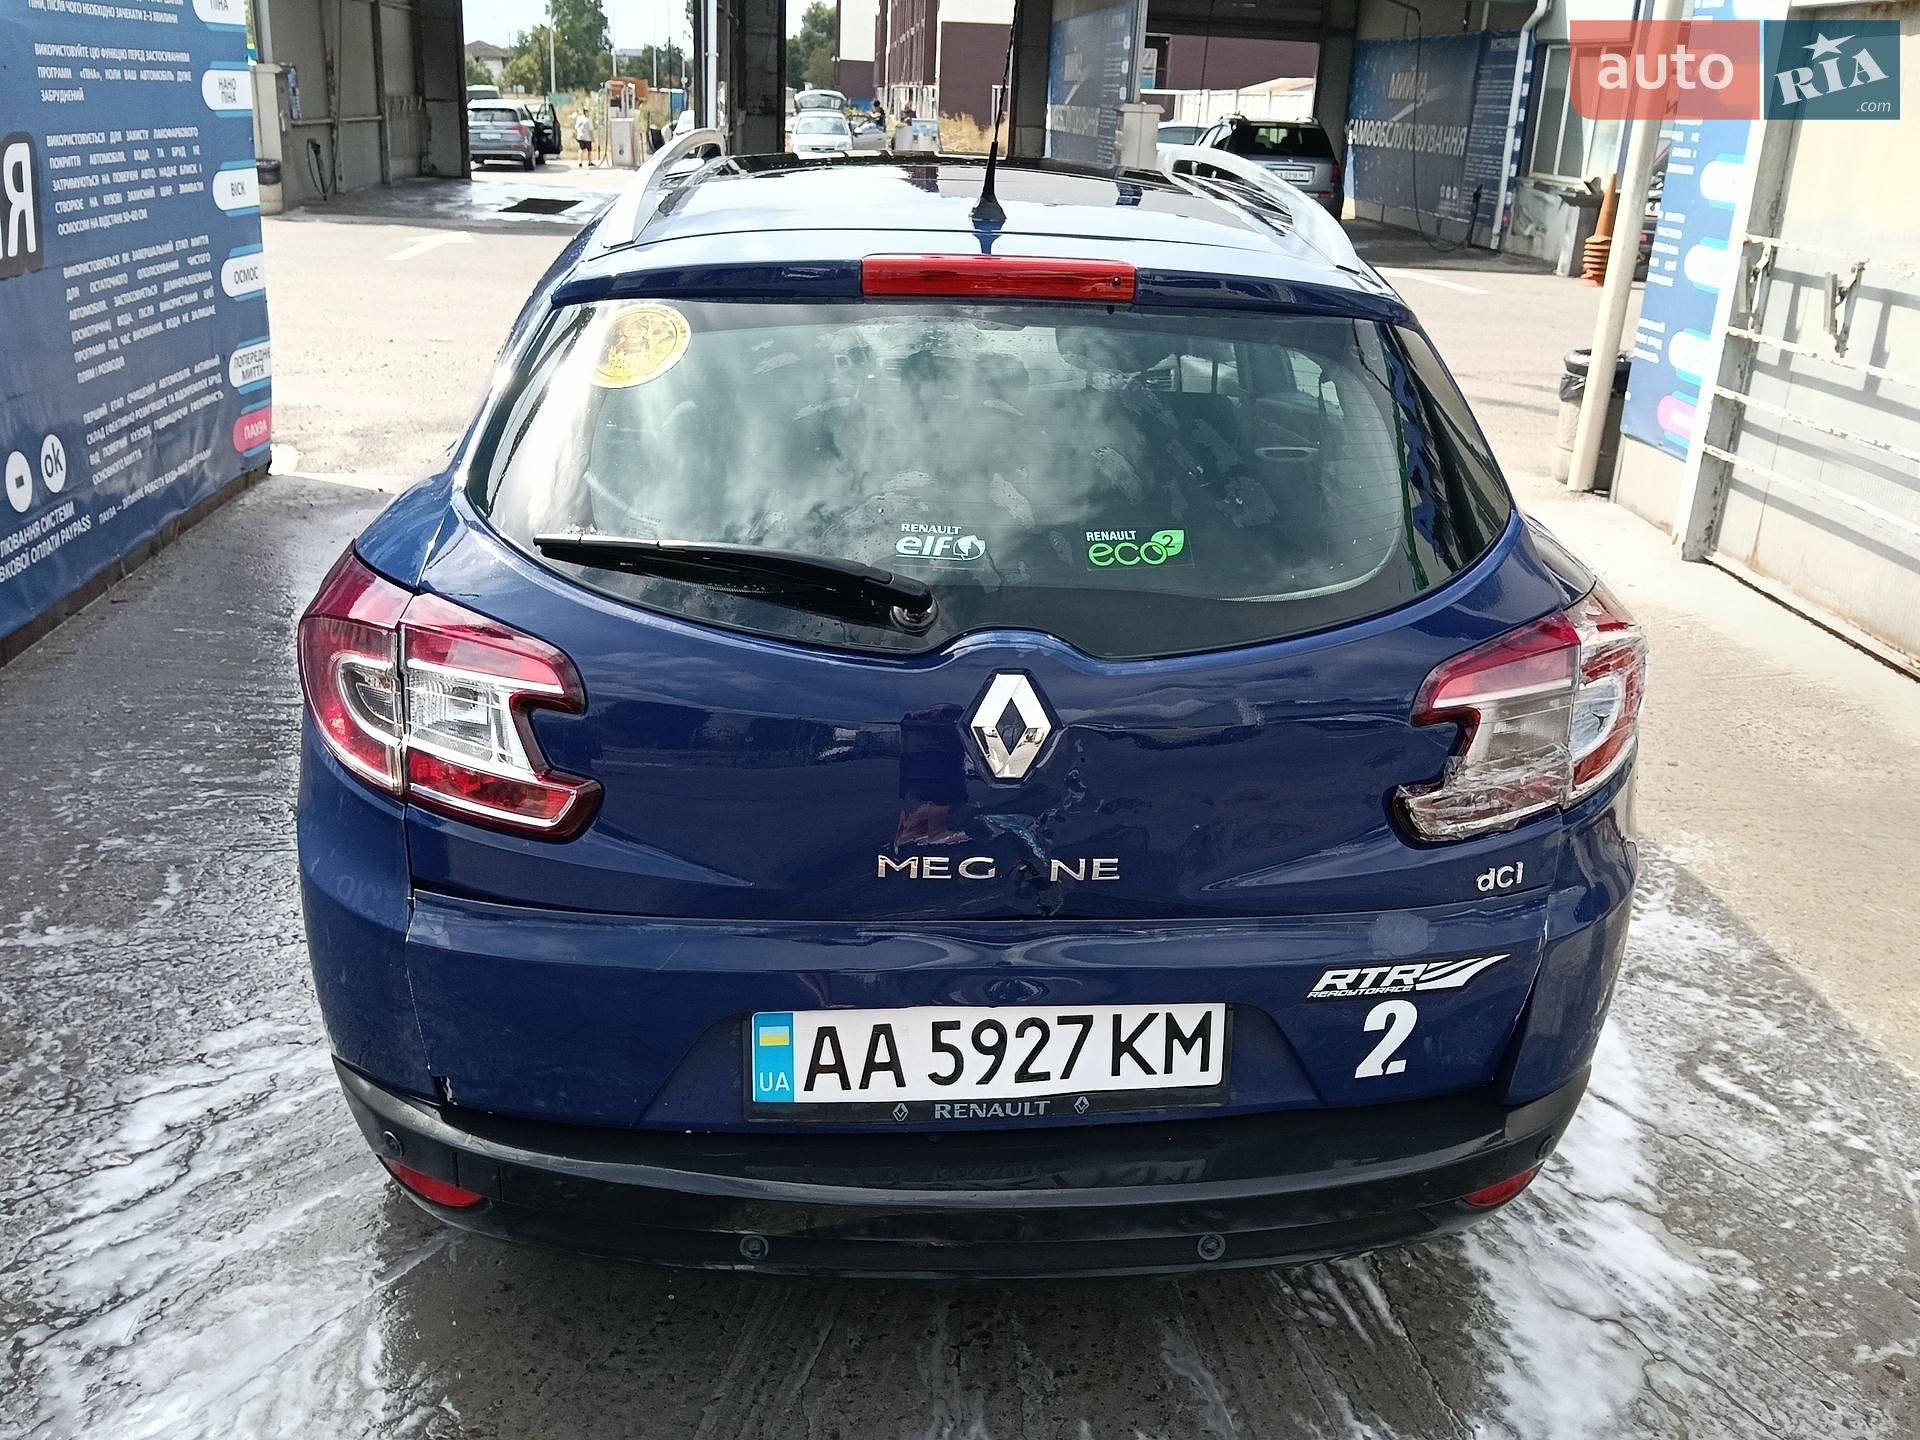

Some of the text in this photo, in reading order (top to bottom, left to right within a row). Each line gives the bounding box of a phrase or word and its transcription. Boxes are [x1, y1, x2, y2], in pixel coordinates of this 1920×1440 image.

[65, 2, 82, 14] ЧОГО
[82, 4, 114, 20] НЕОБХІДНО
[115, 7, 143, 20] ЗАЧЕКАТИ
[34, 44, 89, 58] ВИКОРИСТОВУЙТЕ
[128, 49, 146, 62] ПЕРЕД
[38, 66, 72, 80] ПРОГРАМИ
[124, 70, 137, 81] ВАШ
[41, 87, 84, 103] ЗАБРУДНЕНИЙ
[46, 132, 106, 147] ВИКОРИСТОВУЄТЬСЯ
[102, 174, 111, 185] НА
[230, 181, 246, 197] ВІСК
[89, 196, 99, 208] НА
[234, 267, 258, 285] ОСМОС
[244, 418, 268, 442] ПАУЗА
[44, 442, 64, 478] ok
[41, 500, 75, 533] СИСТЕМИ
[900, 523, 962, 535] RENAULT
[1085, 530, 1138, 542] RENAULT
[31, 532, 61, 564] ОПЛАТИ
[60, 514, 92, 546] PAYPASS
[896, 535, 952, 557] elf
[877, 854, 1121, 882] MEGNE
[1312, 963, 1427, 991] RTR
[1354, 1000, 1418, 1078] 2
[803, 1010, 1213, 1092] AA 5927 KM
[759, 1071, 790, 1092] UA
[934, 1100, 1049, 1120] RENAULT
